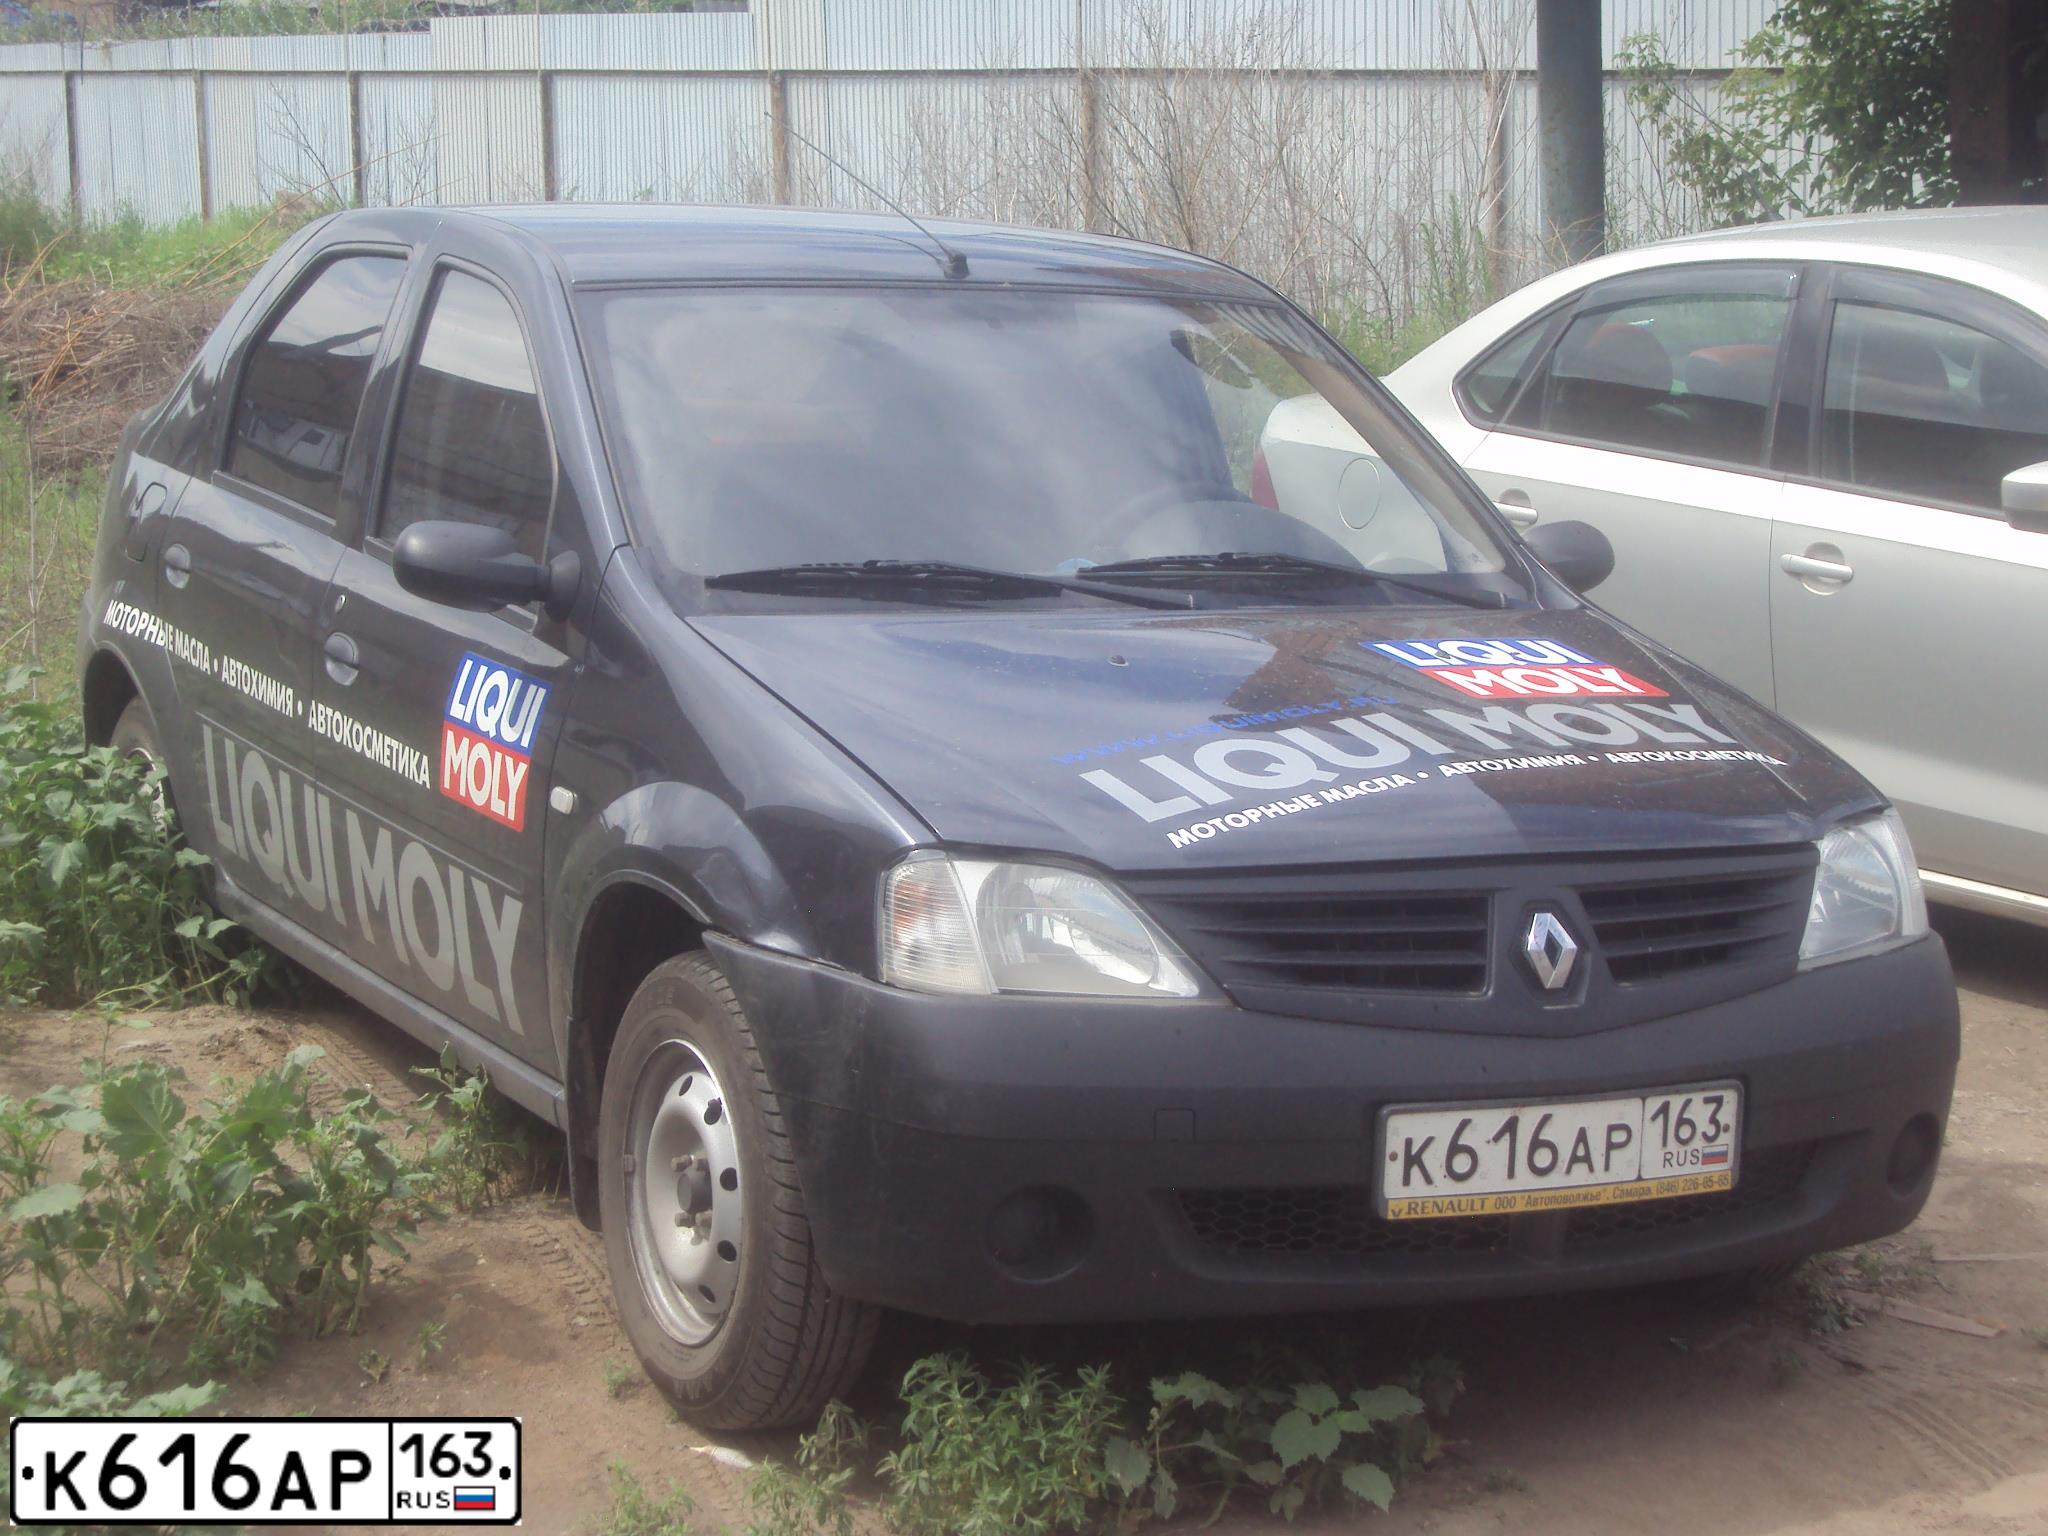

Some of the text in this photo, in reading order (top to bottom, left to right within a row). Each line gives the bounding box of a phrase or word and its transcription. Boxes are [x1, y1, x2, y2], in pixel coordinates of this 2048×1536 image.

[104, 600, 431, 789] МОТОРНЫЕ МАСЛА АВТОХИМИЯ АВТОКОСМЕТИКА
[1373, 640, 1594, 667] LIQUI
[1434, 668, 1645, 695] MOLY
[449, 659, 546, 748] LIQUI
[444, 730, 527, 822] MOLY
[1079, 703, 1738, 823] LIQUI MOLY
[1167, 750, 1788, 848] МОТОРНЫЕ МАСЛА АВТОХИМИЯ АВТОКОСМЕТИКА
[203, 725, 524, 1037] LIQUI MOLY
[1650, 1095, 1725, 1148] 163
[1663, 1149, 1700, 1169] RUS
[1406, 1198, 1489, 1215] RENAULT
